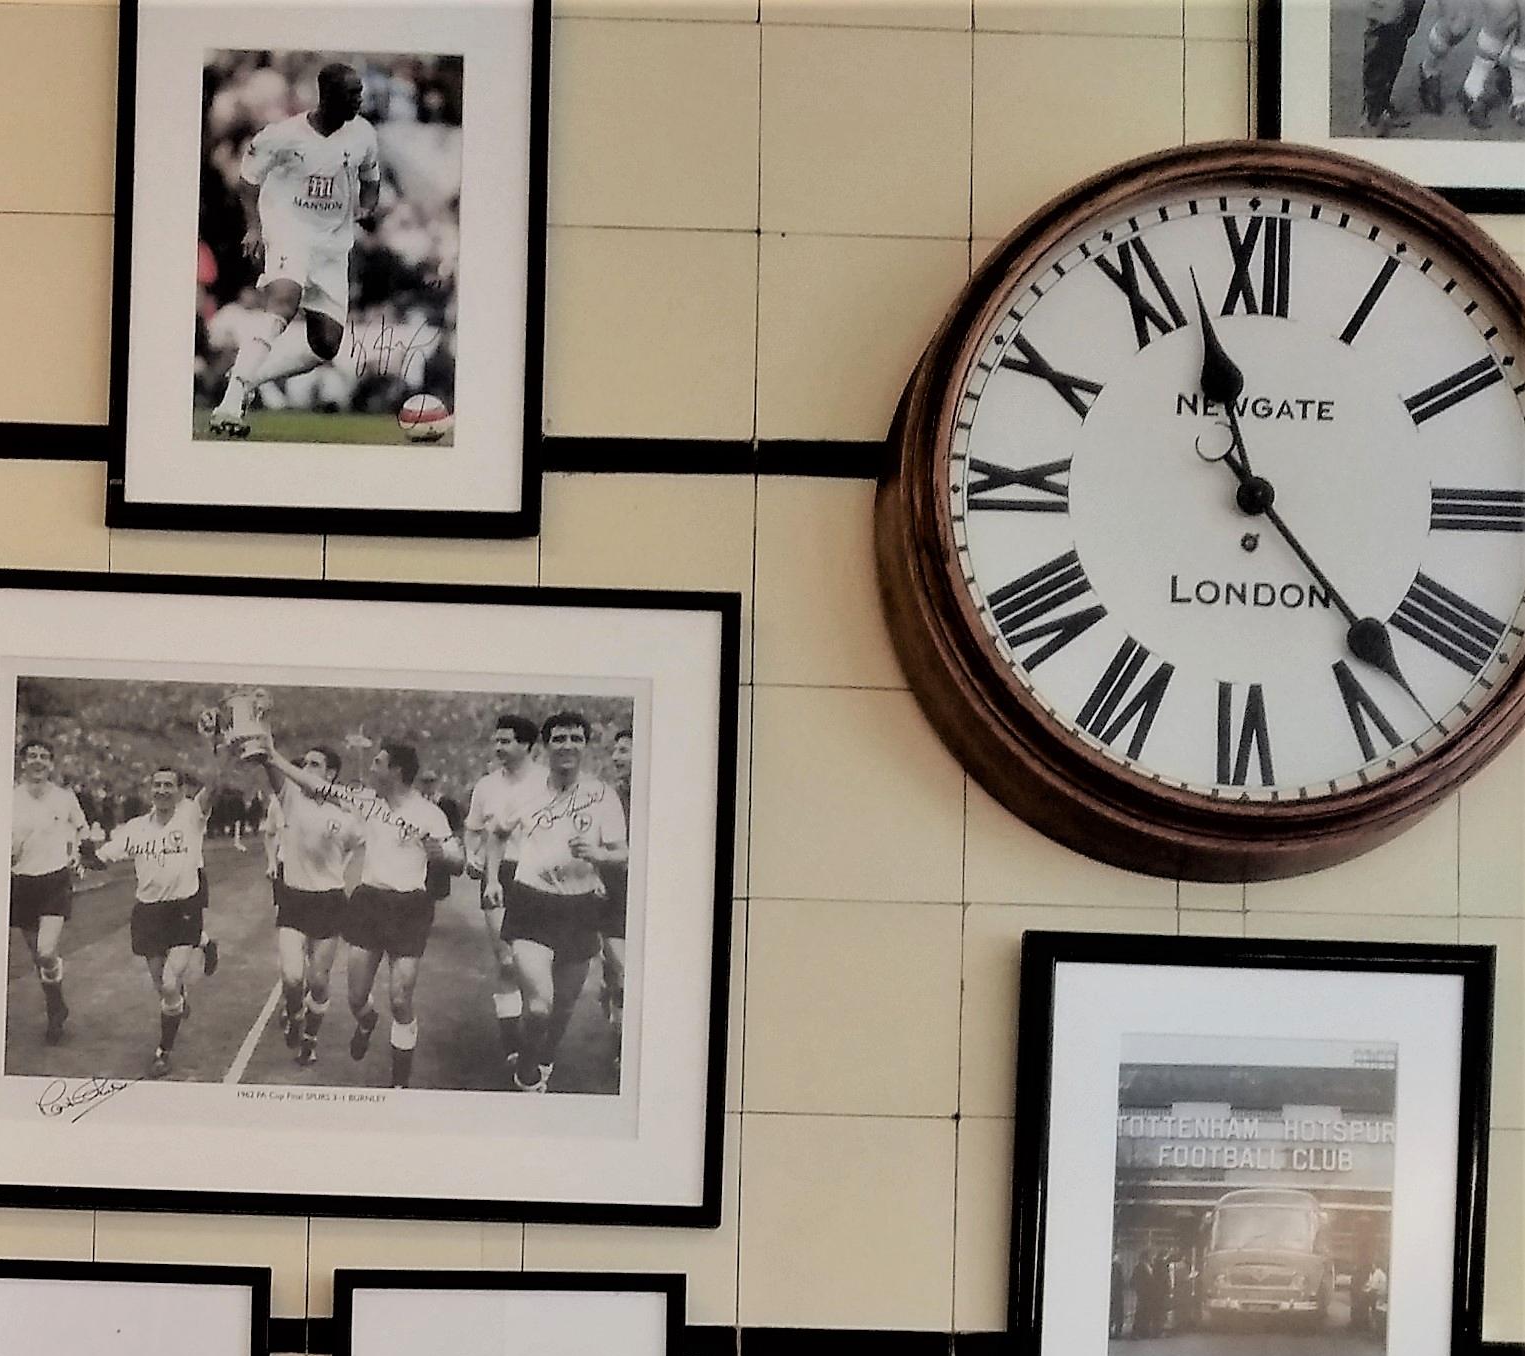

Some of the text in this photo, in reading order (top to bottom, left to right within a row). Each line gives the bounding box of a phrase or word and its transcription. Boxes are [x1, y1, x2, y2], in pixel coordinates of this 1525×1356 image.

[1176, 392, 1335, 423] NEWGATE
[1169, 573, 1332, 611] LONDON
[1116, 1114, 1397, 1145] TOTTENHAM HOTSPUR
[1158, 1144, 1355, 1172] FOOTBALL CLUB
